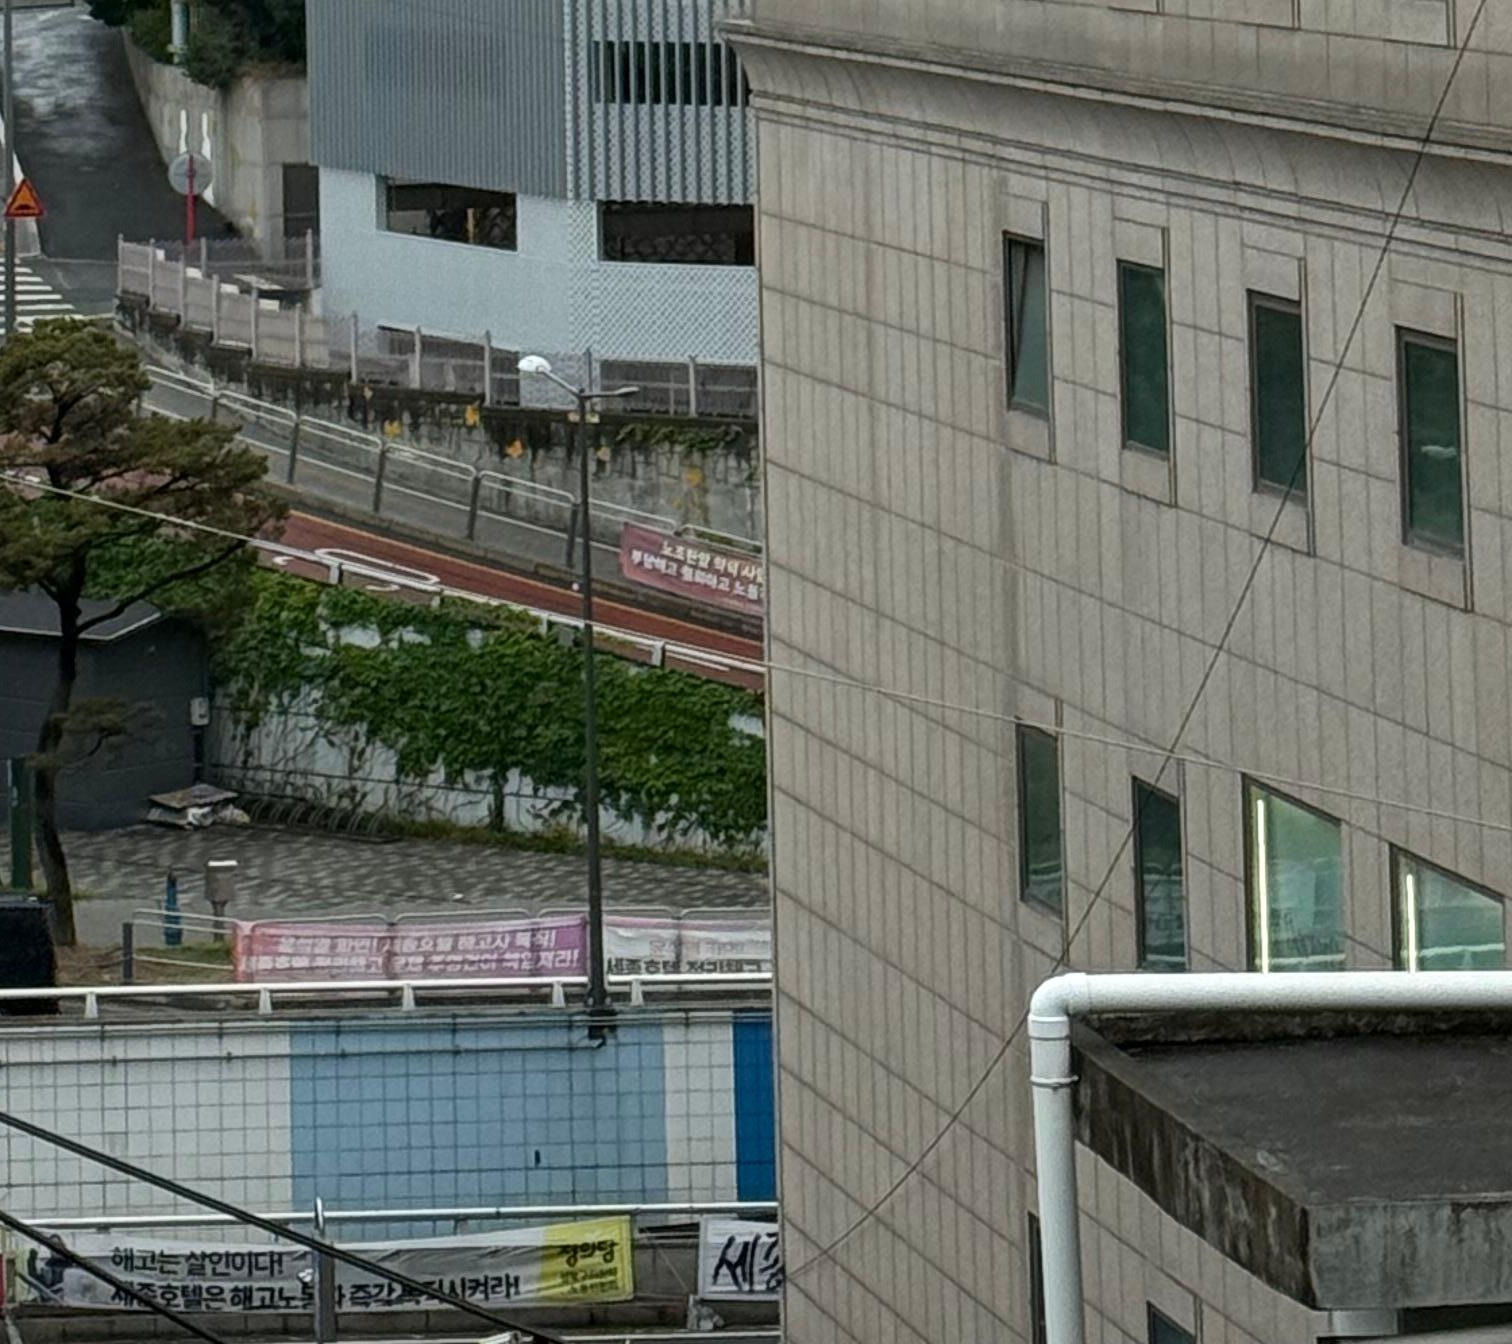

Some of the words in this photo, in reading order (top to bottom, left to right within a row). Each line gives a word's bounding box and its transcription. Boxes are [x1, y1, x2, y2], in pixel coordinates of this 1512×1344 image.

[659, 541, 711, 569] 노조탄압
[458, 933, 509, 950] 해고자
[515, 930, 556, 947] 복직!
[111, 1246, 182, 1274] 해고는
[186, 1249, 283, 1276] 살인이다!
[559, 1240, 619, 1267] 정의당
